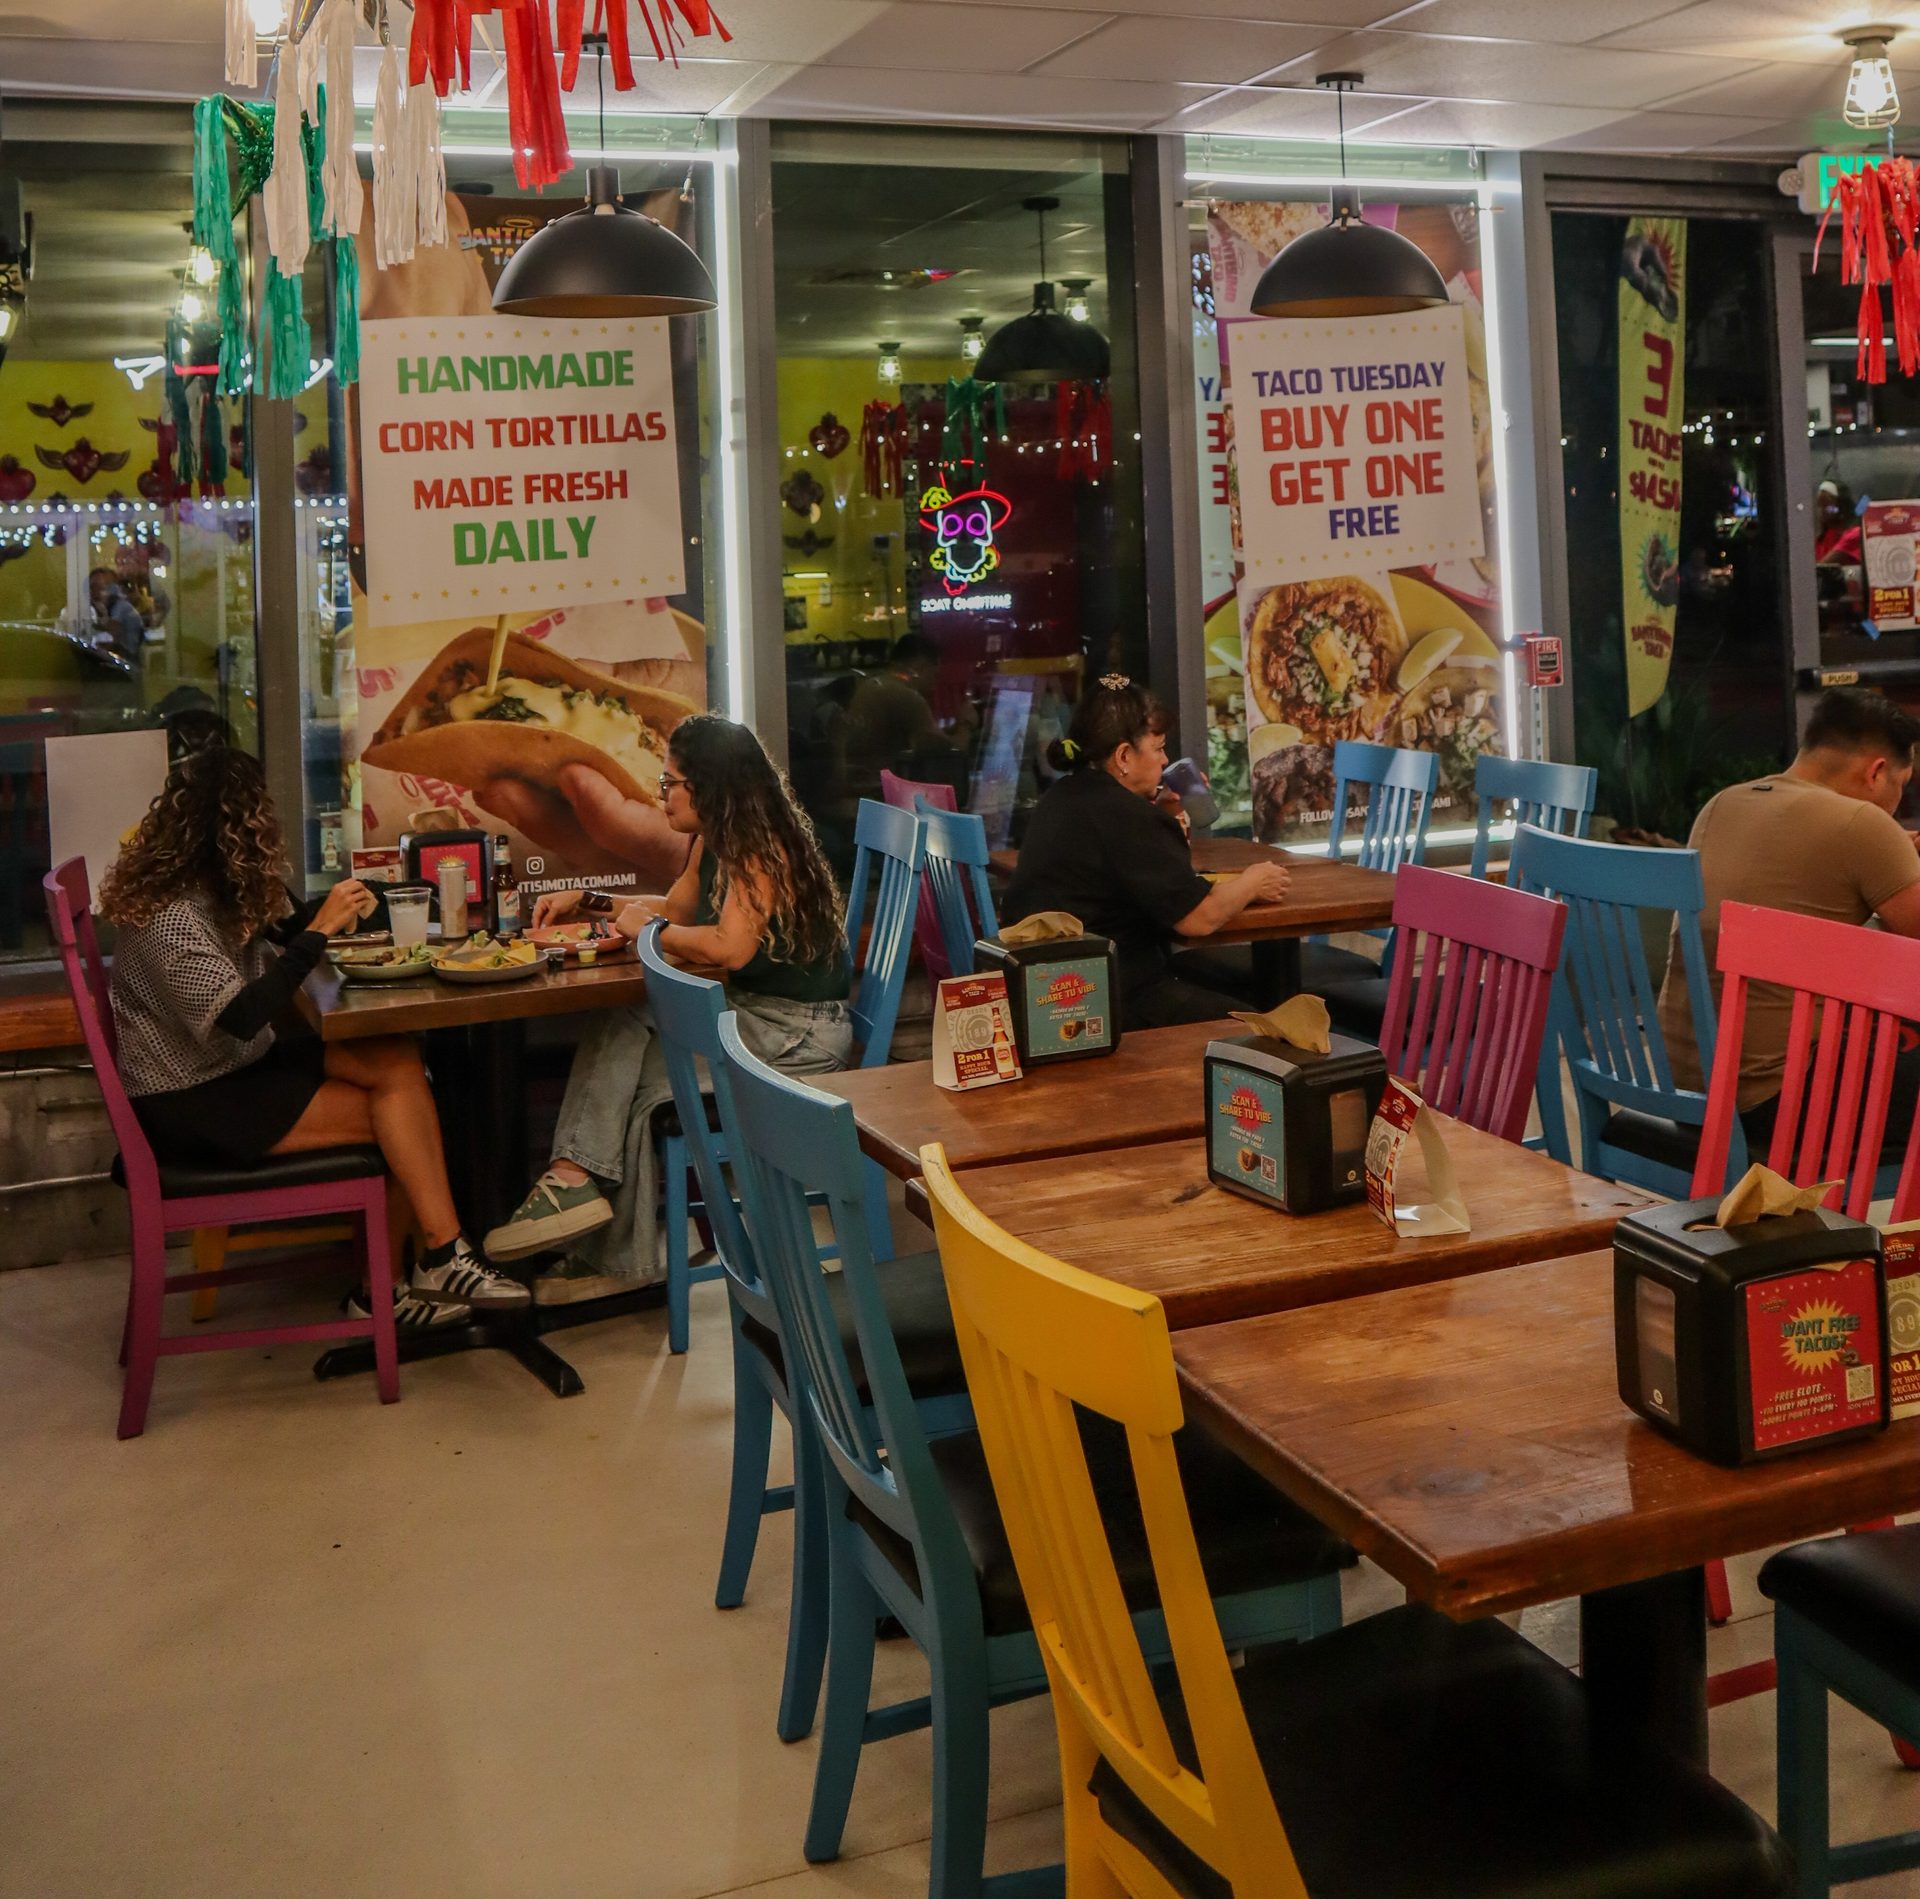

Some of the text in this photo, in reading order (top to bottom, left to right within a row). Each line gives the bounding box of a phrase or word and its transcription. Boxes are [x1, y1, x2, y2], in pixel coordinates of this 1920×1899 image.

[397, 350, 635, 394] HANDMADE
[1252, 368, 1322, 397] TACO
[1330, 361, 1446, 393] TUESDAY
[378, 411, 667, 453] CORN TORTILLAS
[1260, 404, 1350, 452] BUY
[1365, 399, 1445, 445] ONE
[413, 470, 628, 510] MADE FRESH
[1269, 458, 1351, 506] GET
[1365, 452, 1445, 498] ONE
[1328, 504, 1400, 540] FREE
[453, 516, 597, 566] DAILY
[1535, 640, 1559, 653] FIRE
[1036, 993, 1064, 1007] SHARE
[1078, 983, 1097, 995] VIBE
[1050, 981, 1072, 993] SCAN
[957, 1054, 966, 1064] 2
[983, 1050, 990, 1060] 1
[1219, 1104, 1243, 1117] SHARE
[1255, 1110, 1272, 1123] VIBE
[1231, 1095, 1250, 1108] SCAN
[1781, 1314, 1860, 1338] WANT FREE
[1891, 1359, 1912, 1373] OR
